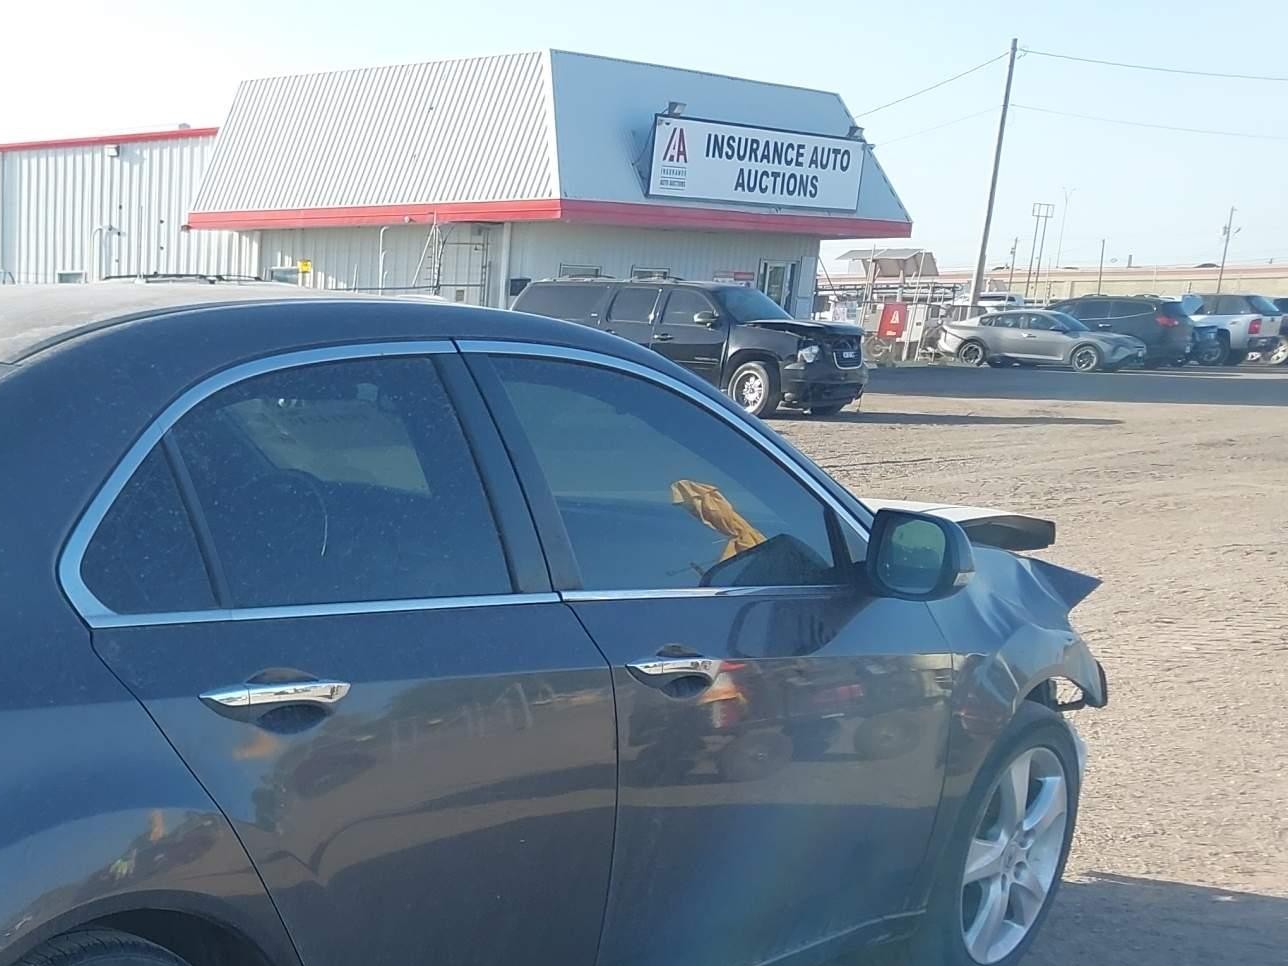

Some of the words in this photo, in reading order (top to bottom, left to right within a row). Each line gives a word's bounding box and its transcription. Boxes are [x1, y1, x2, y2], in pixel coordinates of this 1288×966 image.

[705, 133, 806, 168] INSURANCE
[808, 146, 851, 172] AUTO
[734, 168, 819, 199] AUCTIONS
